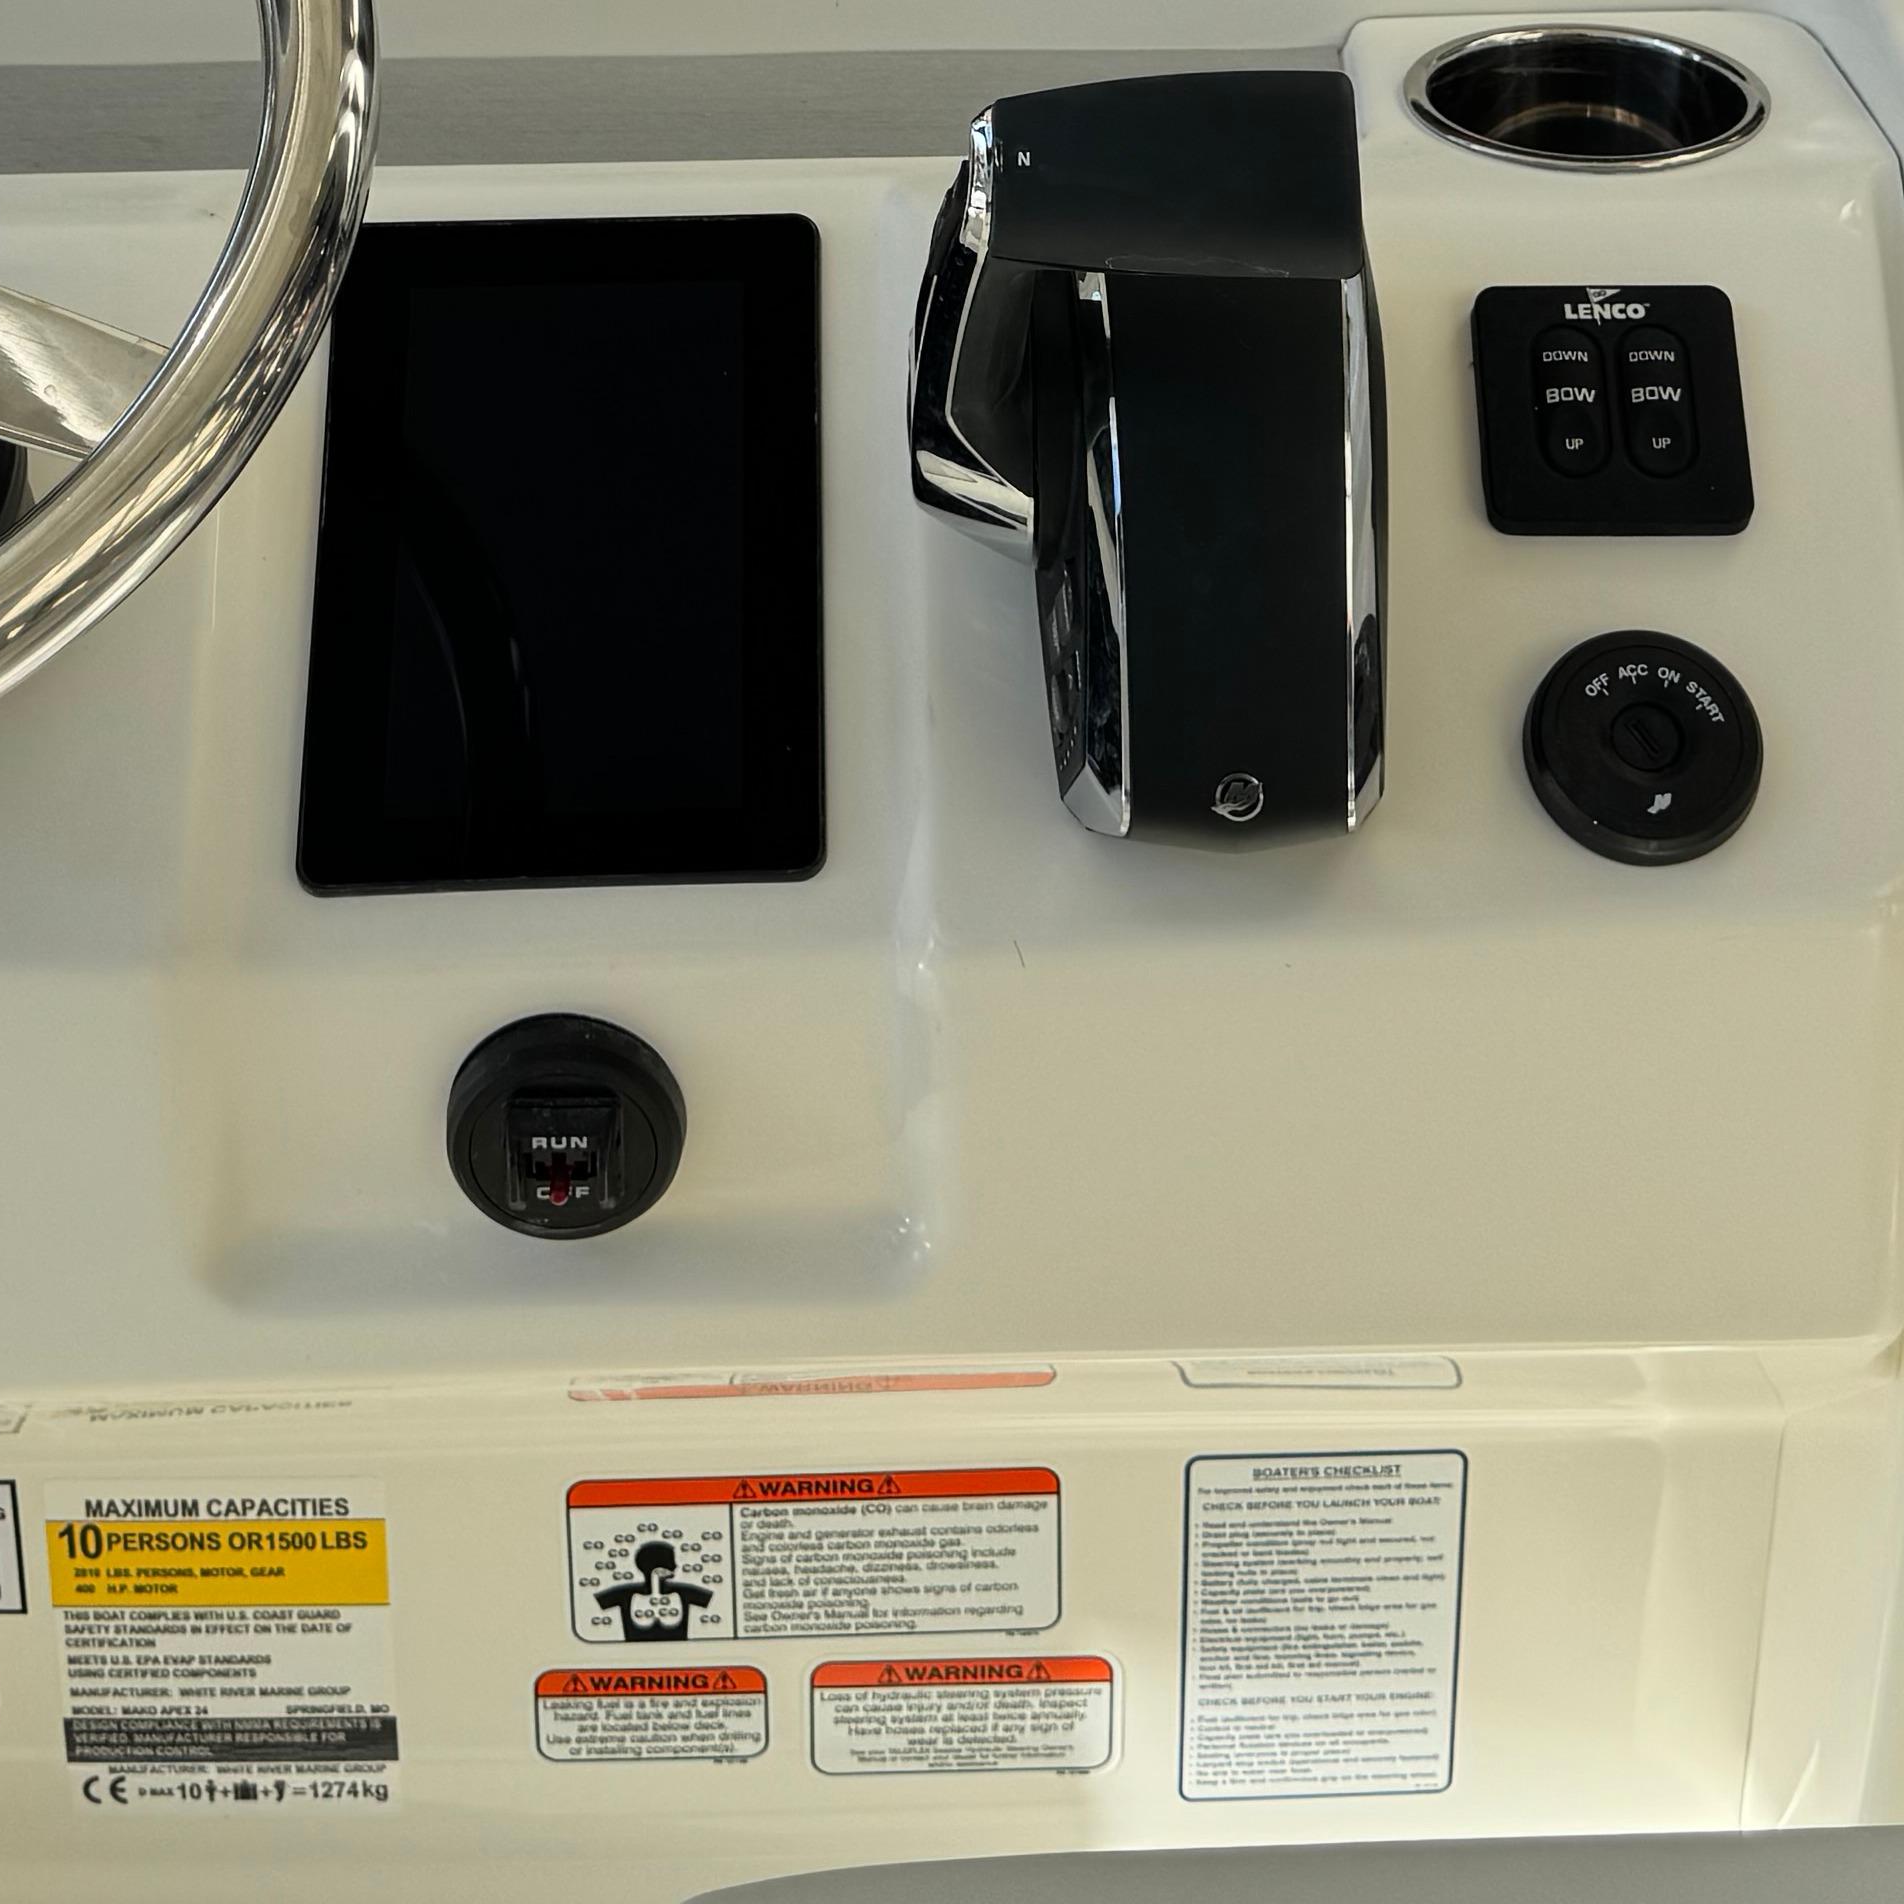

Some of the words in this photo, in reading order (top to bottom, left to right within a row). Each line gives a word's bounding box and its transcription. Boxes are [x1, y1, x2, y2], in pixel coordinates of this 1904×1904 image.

[1017, 151, 1032, 167] N
[1564, 303, 1646, 319] LENCO
[1543, 350, 1588, 362] DOWN
[1629, 350, 1675, 362] DOWN
[1546, 387, 1595, 404] BOW
[1631, 386, 1681, 403] BOW
[1565, 438, 1584, 450] UP
[1652, 437, 1671, 449] UP
[1585, 673, 1609, 697] OFF
[1618, 664, 1648, 679] ACC
[1658, 667, 1680, 683] ON
[1686, 681, 1725, 723] START
[532, 1136, 587, 1149] RUN
[1324, 1465, 1401, 1477] CHECKLIST
[759, 1480, 875, 1496] WARNING
[85, 1498, 199, 1518] MAXIMUM
[206, 1497, 350, 1517] CAPACITIES
[741, 1507, 788, 1518] Carbon
[792, 1505, 856, 1516] monoxide
[637, 1523, 658, 1532] CO
[615, 1535, 635, 1543] CO
[663, 1530, 683, 1539] CO
[702, 1532, 722, 1540] CO
[58, 1522, 103, 1559] 10
[107, 1531, 221, 1552] PERSONS
[228, 1531, 266, 1551] OR
[268, 1531, 317, 1550] 1500
[321, 1531, 368, 1550] LBS
[584, 1541, 604, 1550] CO
[681, 1543, 701, 1552] CO
[608, 1549, 629, 1557] CO
[701, 1554, 722, 1563] CO
[595, 1561, 616, 1570] CO
[682, 1564, 702, 1572] CO
[250, 1567, 285, 1577] GEAR
[613, 1572, 633, 1580] CO
[580, 1578, 600, 1586] CO
[702, 1575, 723, 1584] CO
[133, 1584, 178, 1593] MOTOR
[650, 1597, 670, 1605] CO
[635, 1610, 654, 1618] CO
[659, 1608, 679, 1617] CO
[592, 1617, 612, 1625] CO
[700, 1615, 720, 1623] CO
[65, 1638, 156, 1648] CERTIFICATION
[905, 1665, 1023, 1681] WARNING
[589, 1674, 710, 1691] WARNING
[177, 1783, 202, 1800] 10
